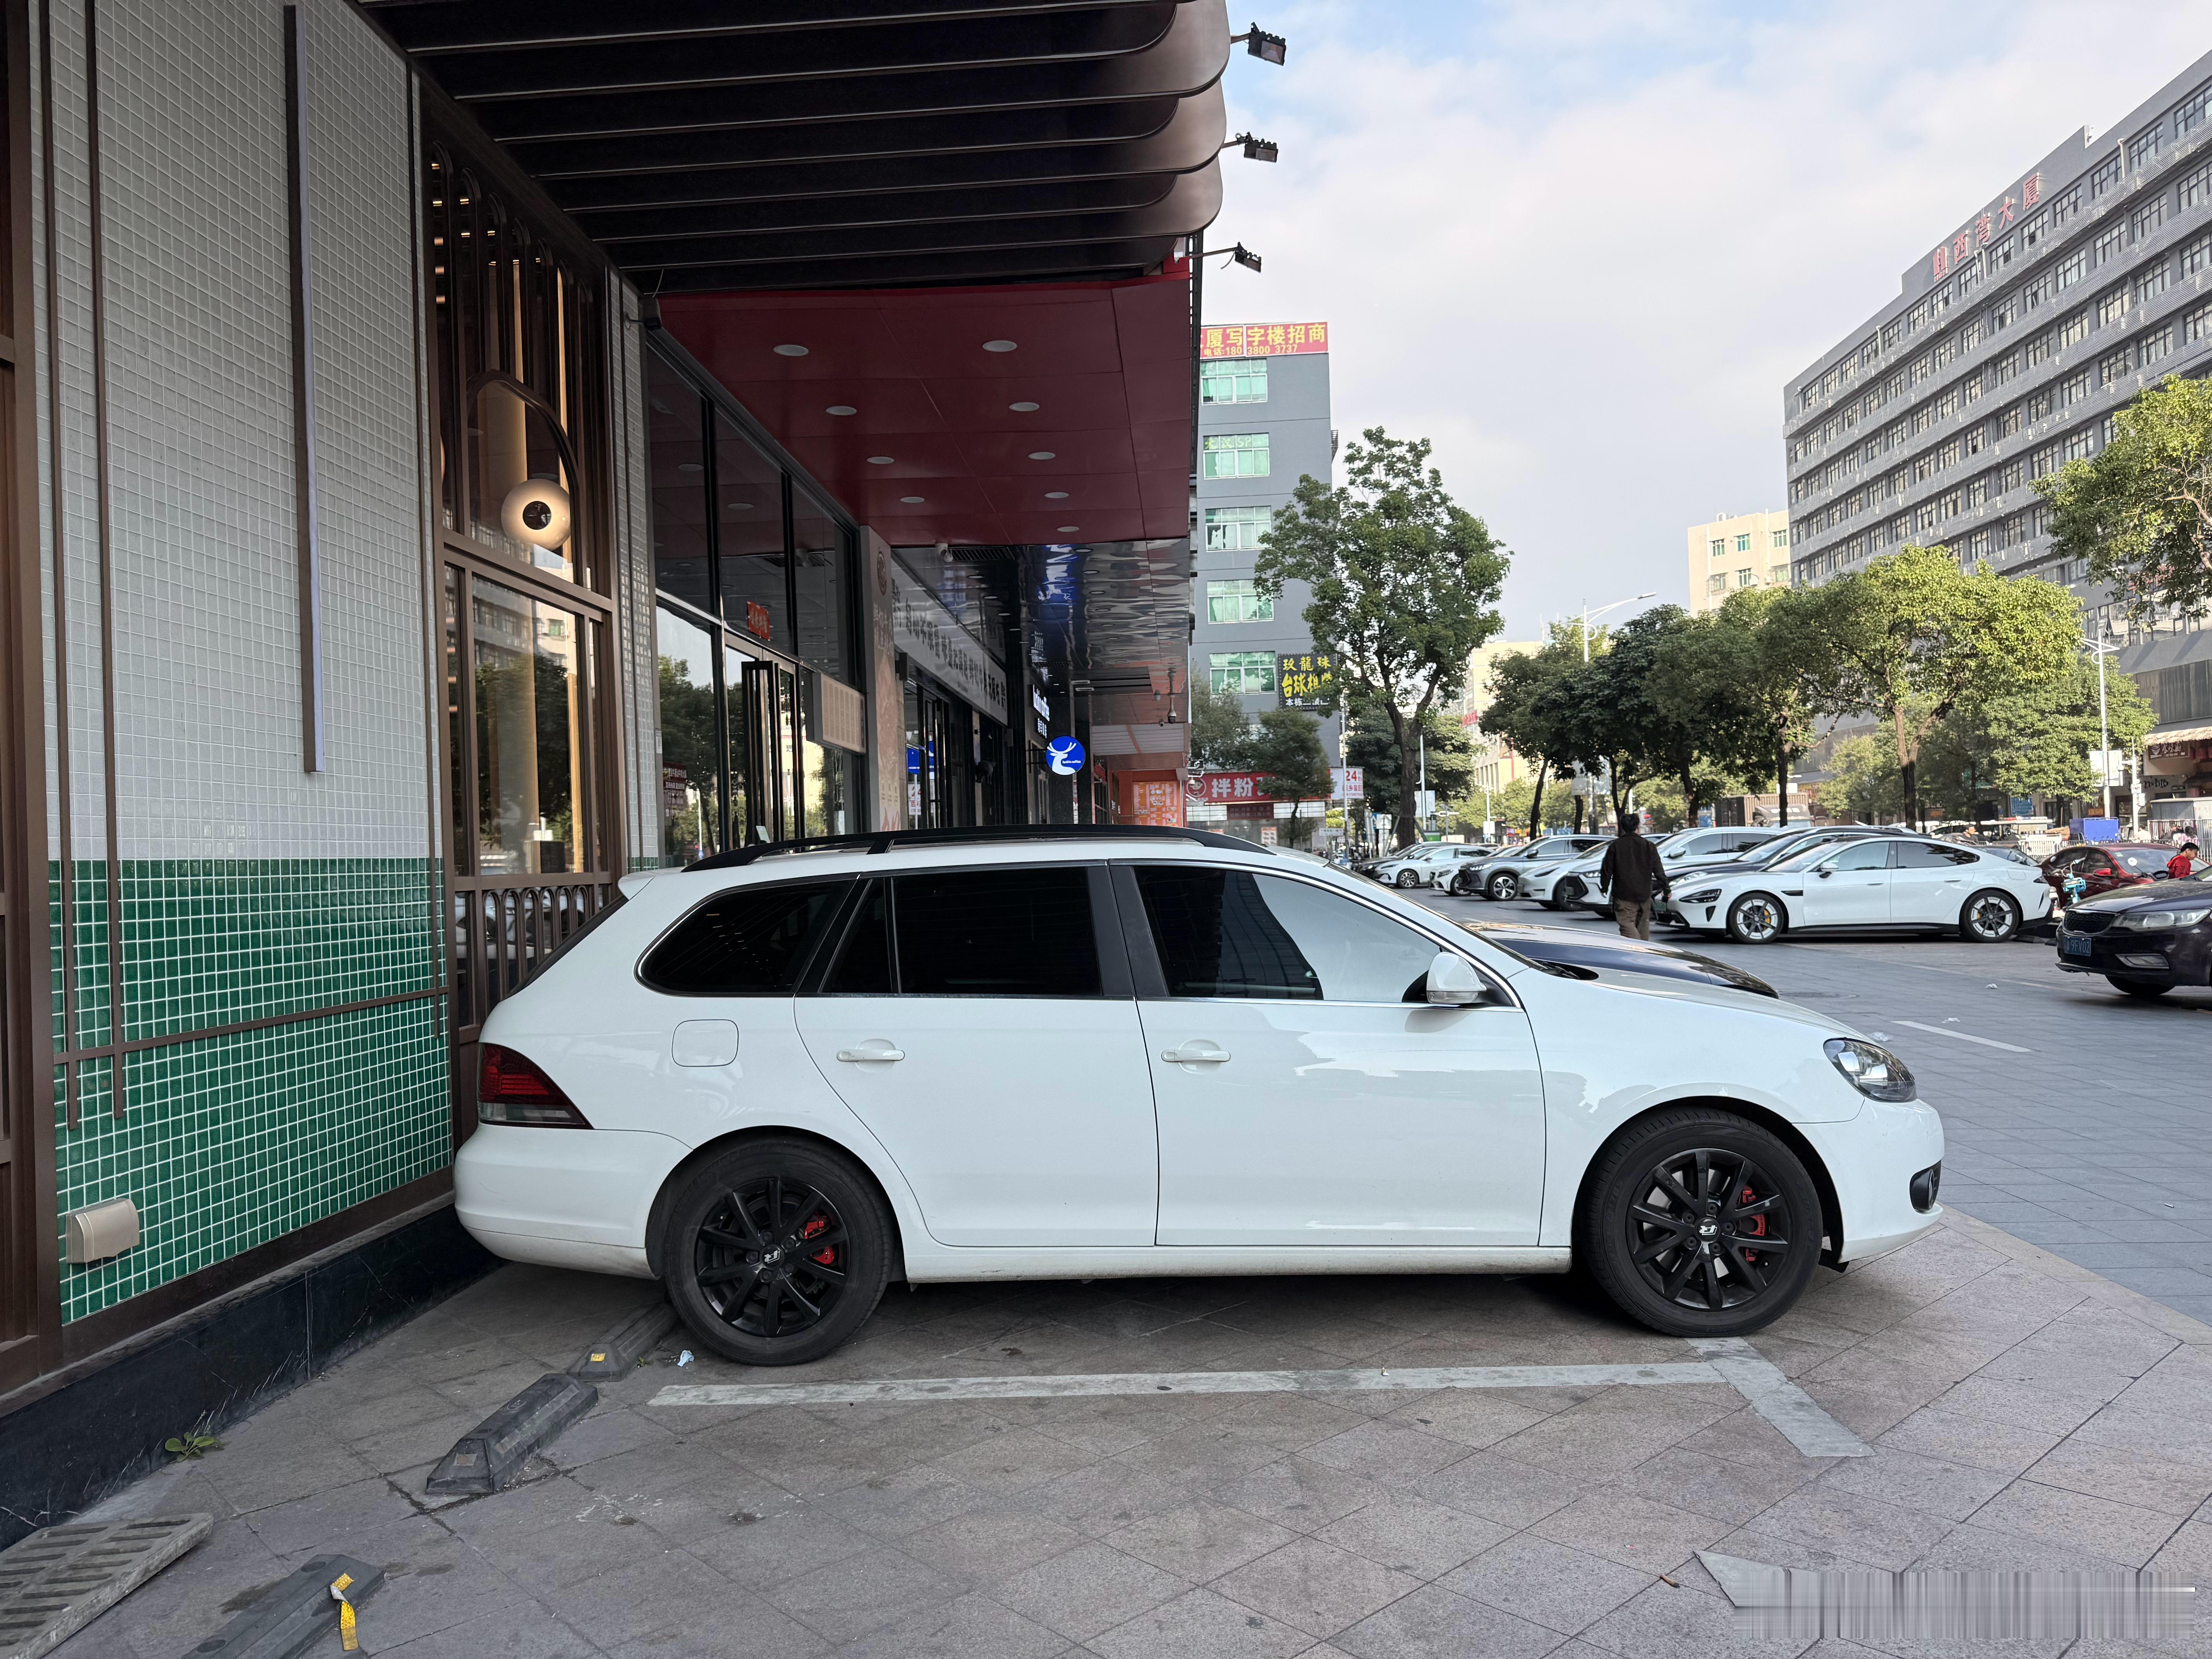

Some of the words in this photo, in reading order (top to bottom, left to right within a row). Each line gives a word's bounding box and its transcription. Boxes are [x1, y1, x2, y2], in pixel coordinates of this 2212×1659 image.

[1953, 172, 2040, 265] 西湾大厦
[1200, 324, 1326, 349] 厦写字楼招商
[1247, 345, 1270, 355] 3800
[1275, 344, 1298, 354] 3737
[1346, 770, 1357, 781] 24
